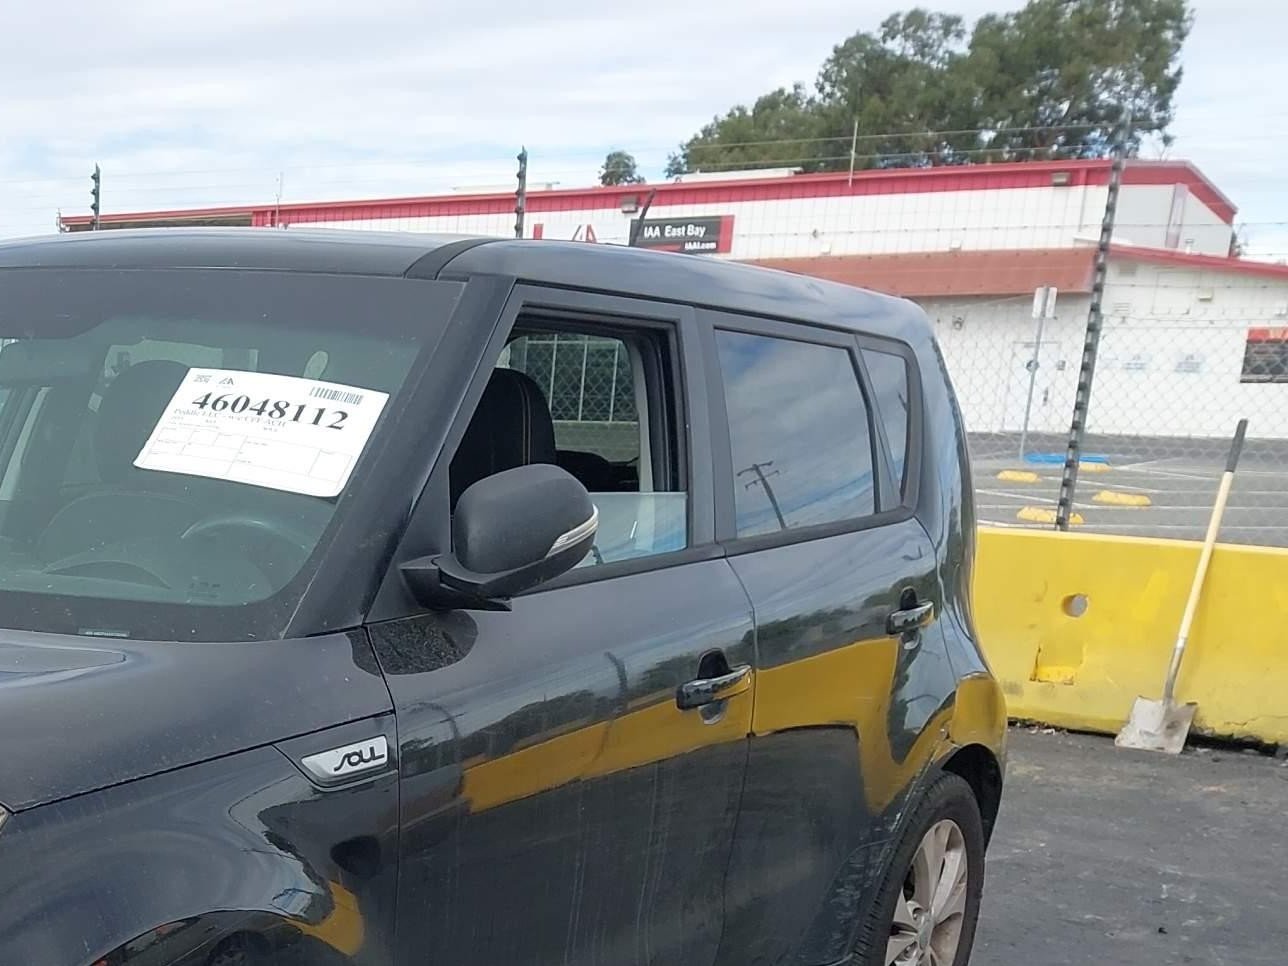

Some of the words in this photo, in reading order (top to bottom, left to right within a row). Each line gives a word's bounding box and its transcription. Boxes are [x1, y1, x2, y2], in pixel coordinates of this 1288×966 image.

[643, 225, 661, 238] IAA
[664, 224, 686, 237] East
[686, 223, 706, 238] Bay
[192, 391, 348, 430] 46048112
[333, 746, 385, 772] SOUL
